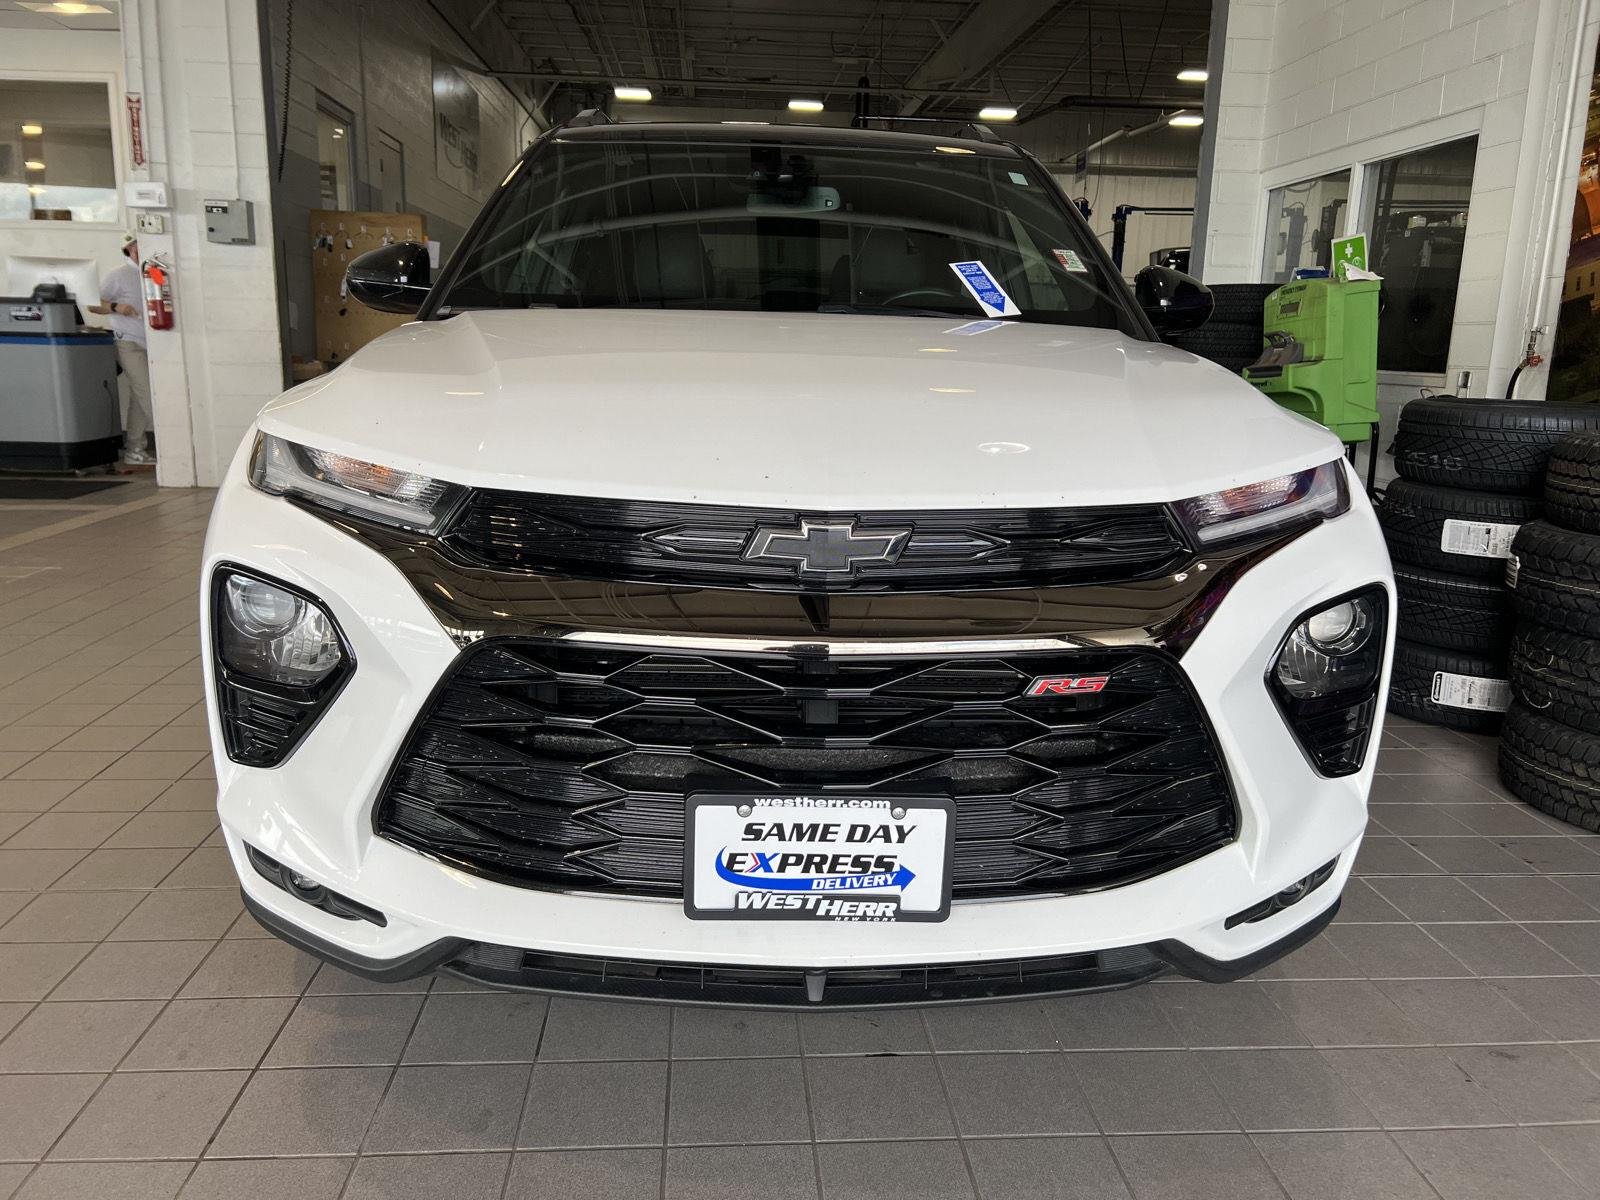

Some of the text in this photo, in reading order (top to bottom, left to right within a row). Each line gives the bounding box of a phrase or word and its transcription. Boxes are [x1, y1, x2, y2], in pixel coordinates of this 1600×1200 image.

[1027, 676, 1109, 696] RS
[753, 797, 891, 809] westherr.com
[741, 822, 917, 844] SAME DAY
[725, 852, 898, 874] EXPRESS
[811, 873, 898, 891] DELIVERY
